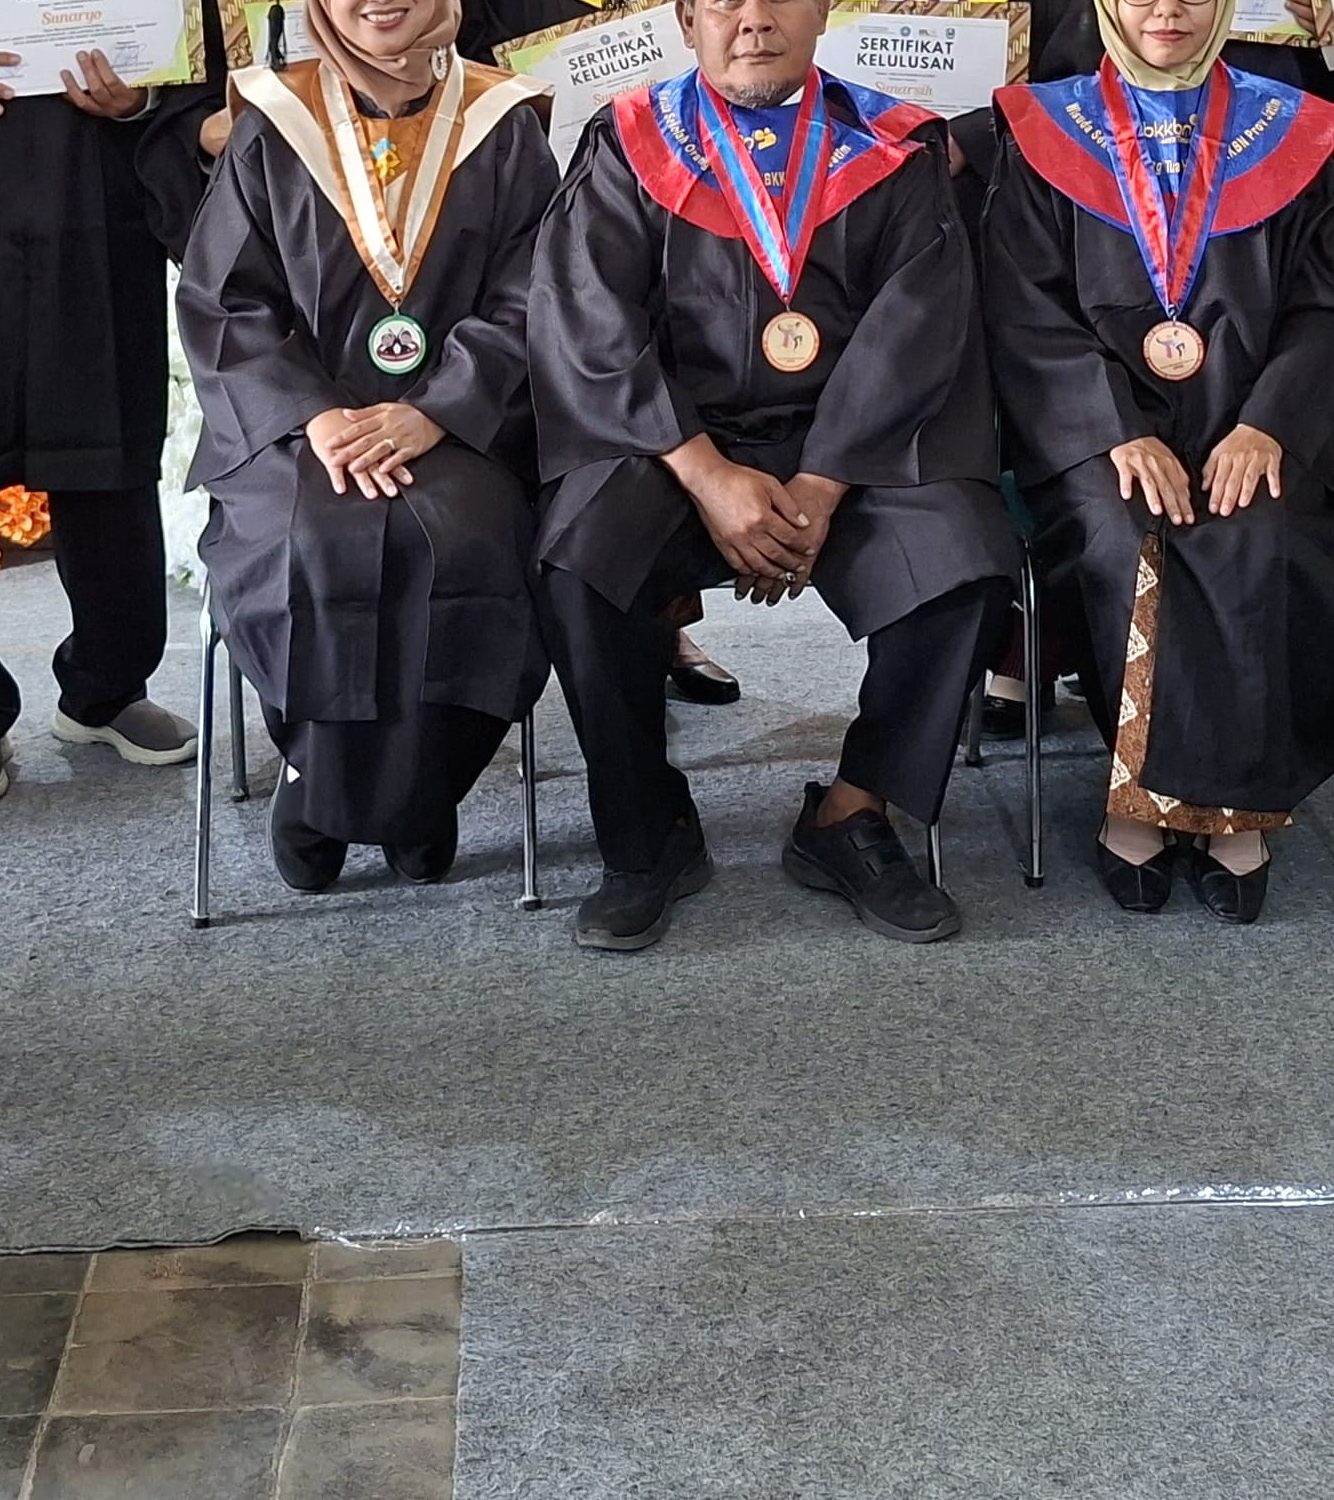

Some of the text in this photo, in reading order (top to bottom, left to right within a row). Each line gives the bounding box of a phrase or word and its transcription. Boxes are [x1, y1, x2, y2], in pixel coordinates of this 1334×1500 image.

[42, 10, 102, 26] Sunaryo
[568, 33, 655, 71] SERTIFIKAT
[860, 37, 954, 55] SERTIFIKAT
[571, 47, 663, 86] KELULUSAN
[856, 53, 955, 71] KELULUSAN
[1065, 102, 1093, 133] Wisuda
[1227, 135, 1250, 159] KBN
[1244, 119, 1268, 140] Prov
[684, 143, 709, 171] Orang
